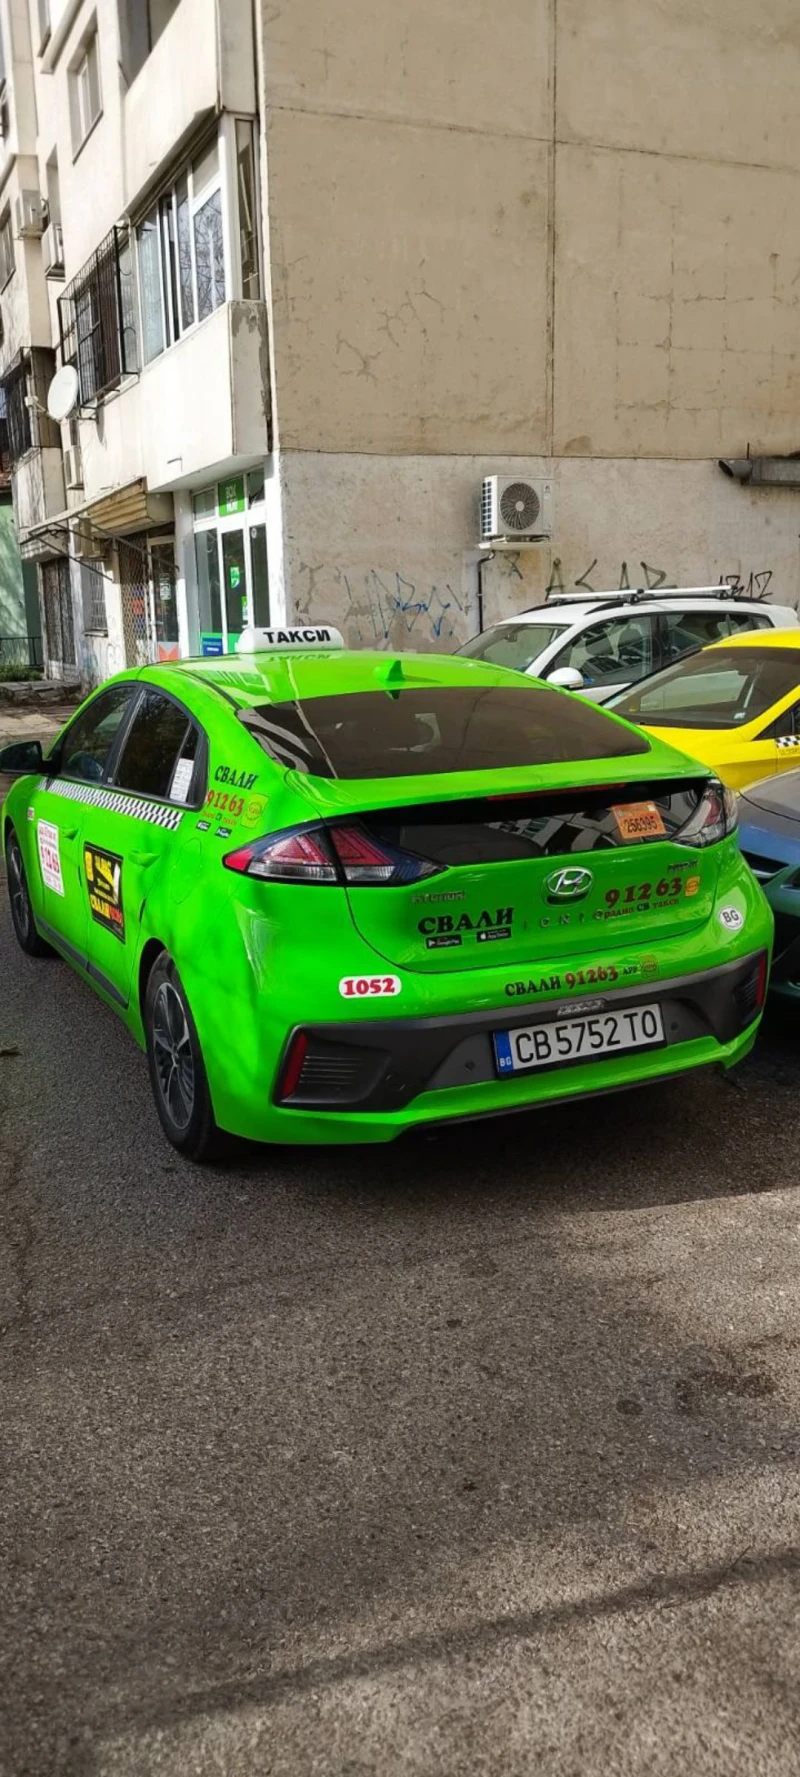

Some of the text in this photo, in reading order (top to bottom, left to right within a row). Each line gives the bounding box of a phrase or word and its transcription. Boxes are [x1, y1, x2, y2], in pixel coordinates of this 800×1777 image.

[263, 629, 331, 644] ТАКСИ
[214, 765, 259, 790] СВАЛИ
[206, 789, 245, 817] 91263
[604, 876, 682, 908] 91263
[417, 907, 514, 935] СВАЛИ
[722, 909, 740, 924] BG
[343, 977, 395, 996] 1052
[504, 975, 561, 997] СВАЛИ
[564, 965, 618, 989] 91263
[555, 1017, 621, 1056] 5752
[499, 1056, 512, 1067] BG
